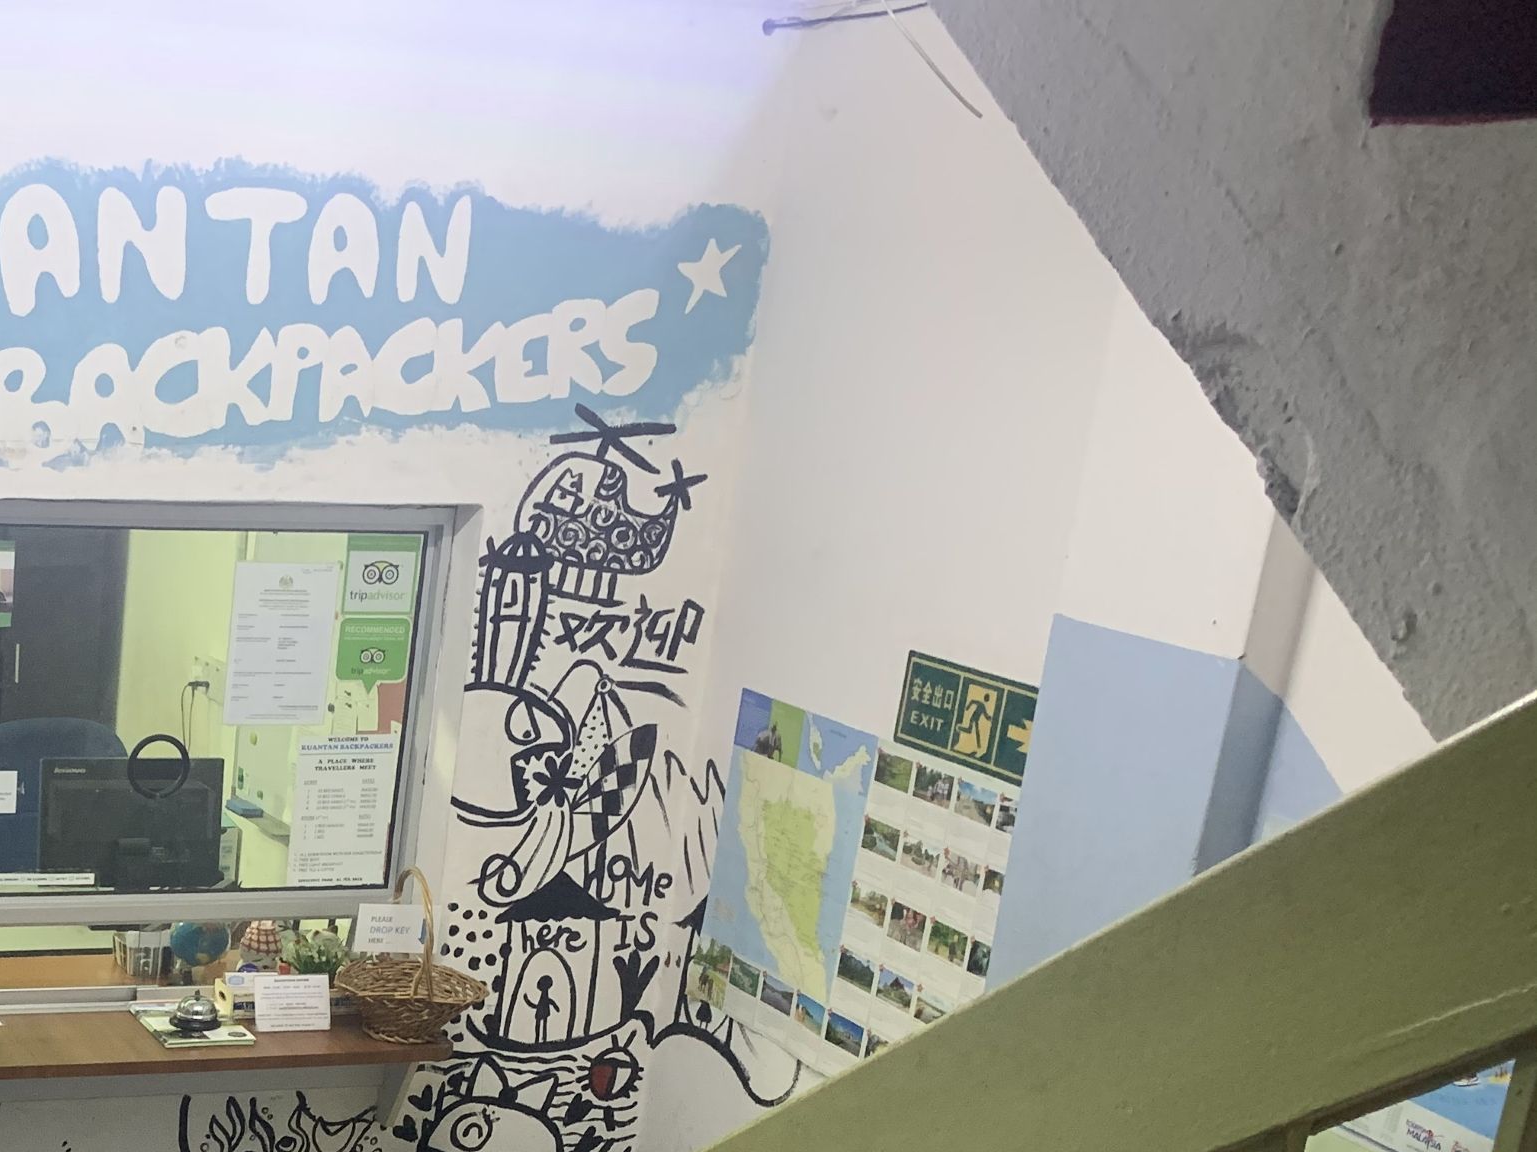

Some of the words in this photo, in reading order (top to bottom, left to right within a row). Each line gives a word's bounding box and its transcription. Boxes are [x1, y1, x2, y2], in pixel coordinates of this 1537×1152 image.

[910, 677, 955, 711] 安全出口
[910, 710, 944, 732] EXIT
[369, 926, 393, 934] DROP
[394, 926, 411, 934] KEY
[520, 919, 587, 954] here
[614, 912, 659, 950] IS
